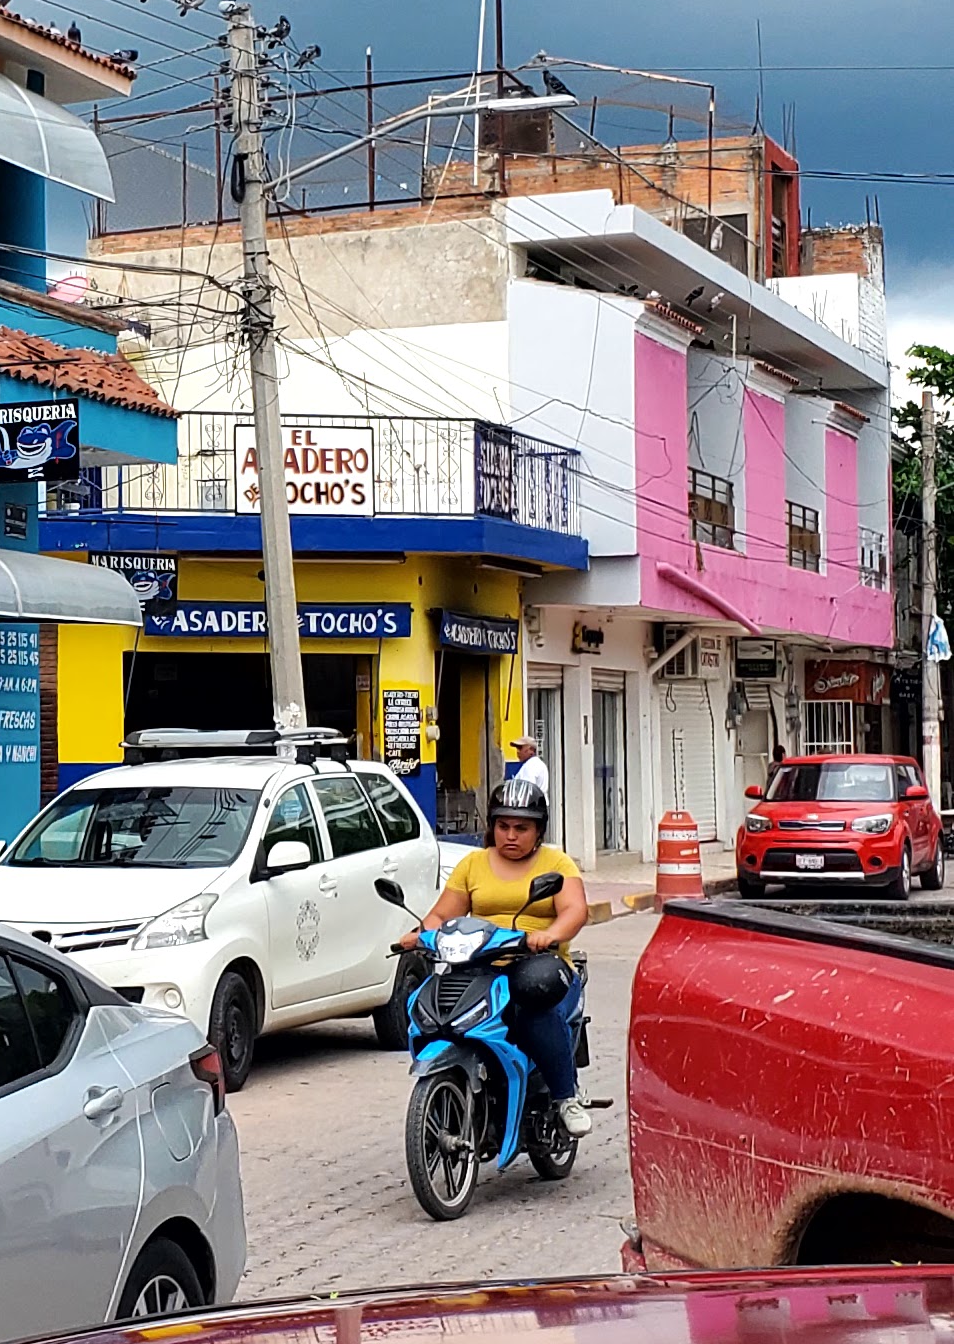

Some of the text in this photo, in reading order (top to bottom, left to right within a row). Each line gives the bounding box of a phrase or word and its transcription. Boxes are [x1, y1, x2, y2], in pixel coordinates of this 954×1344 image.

[291, 430, 318, 446] EL
[241, 447, 369, 475] AADERO
[286, 479, 366, 505] OCHO'S
[91, 555, 176, 571] MARISQUERIA
[171, 610, 268, 633] ASADER
[304, 609, 397, 634] TOCHO'S
[7, 631, 17, 647] 25
[29, 633, 38, 649] 41
[7, 649, 17, 665] 25
[29, 651, 39, 666] 45
